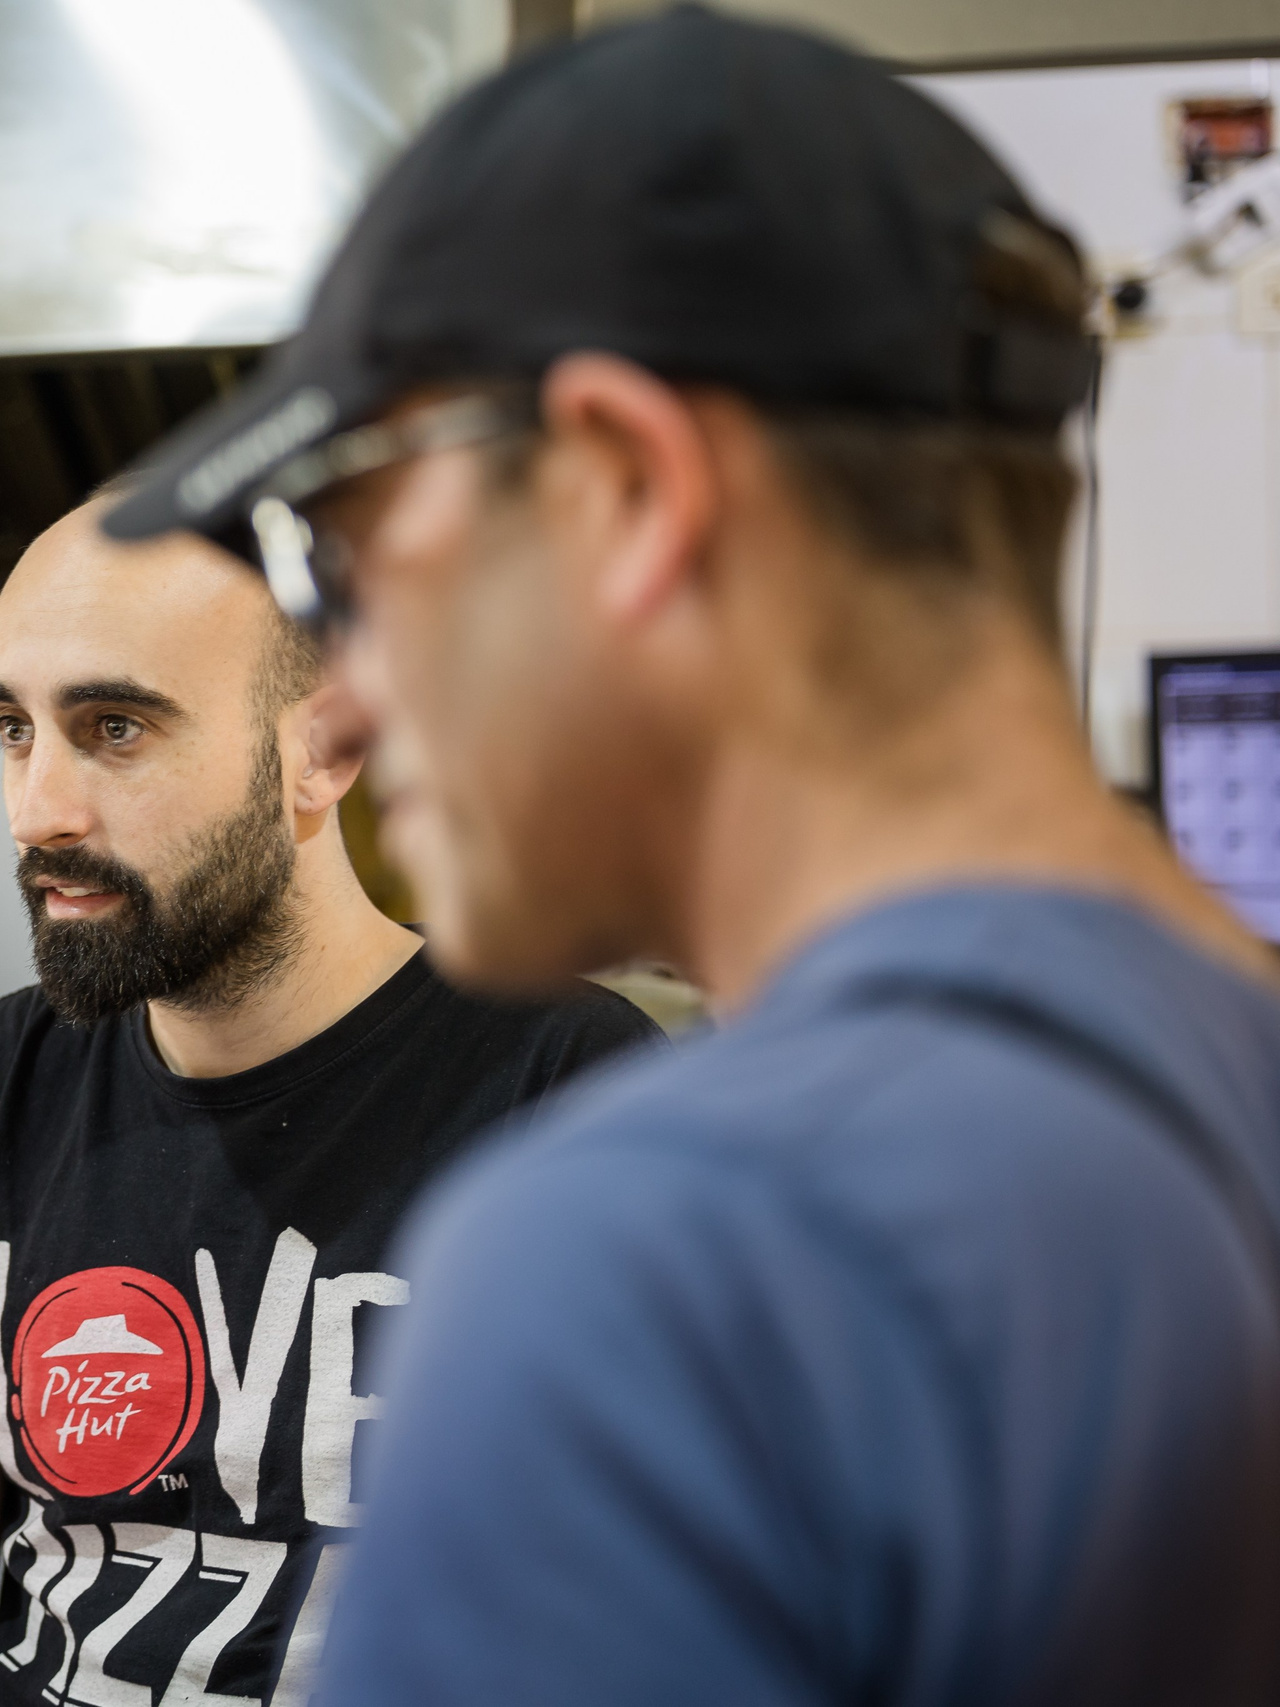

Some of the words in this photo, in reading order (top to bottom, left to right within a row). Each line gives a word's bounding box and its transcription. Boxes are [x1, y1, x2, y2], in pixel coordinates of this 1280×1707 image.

[40, 1359, 152, 1418] Pizza
[55, 1402, 144, 1454] Hut
[157, 1472, 189, 1492] TM
